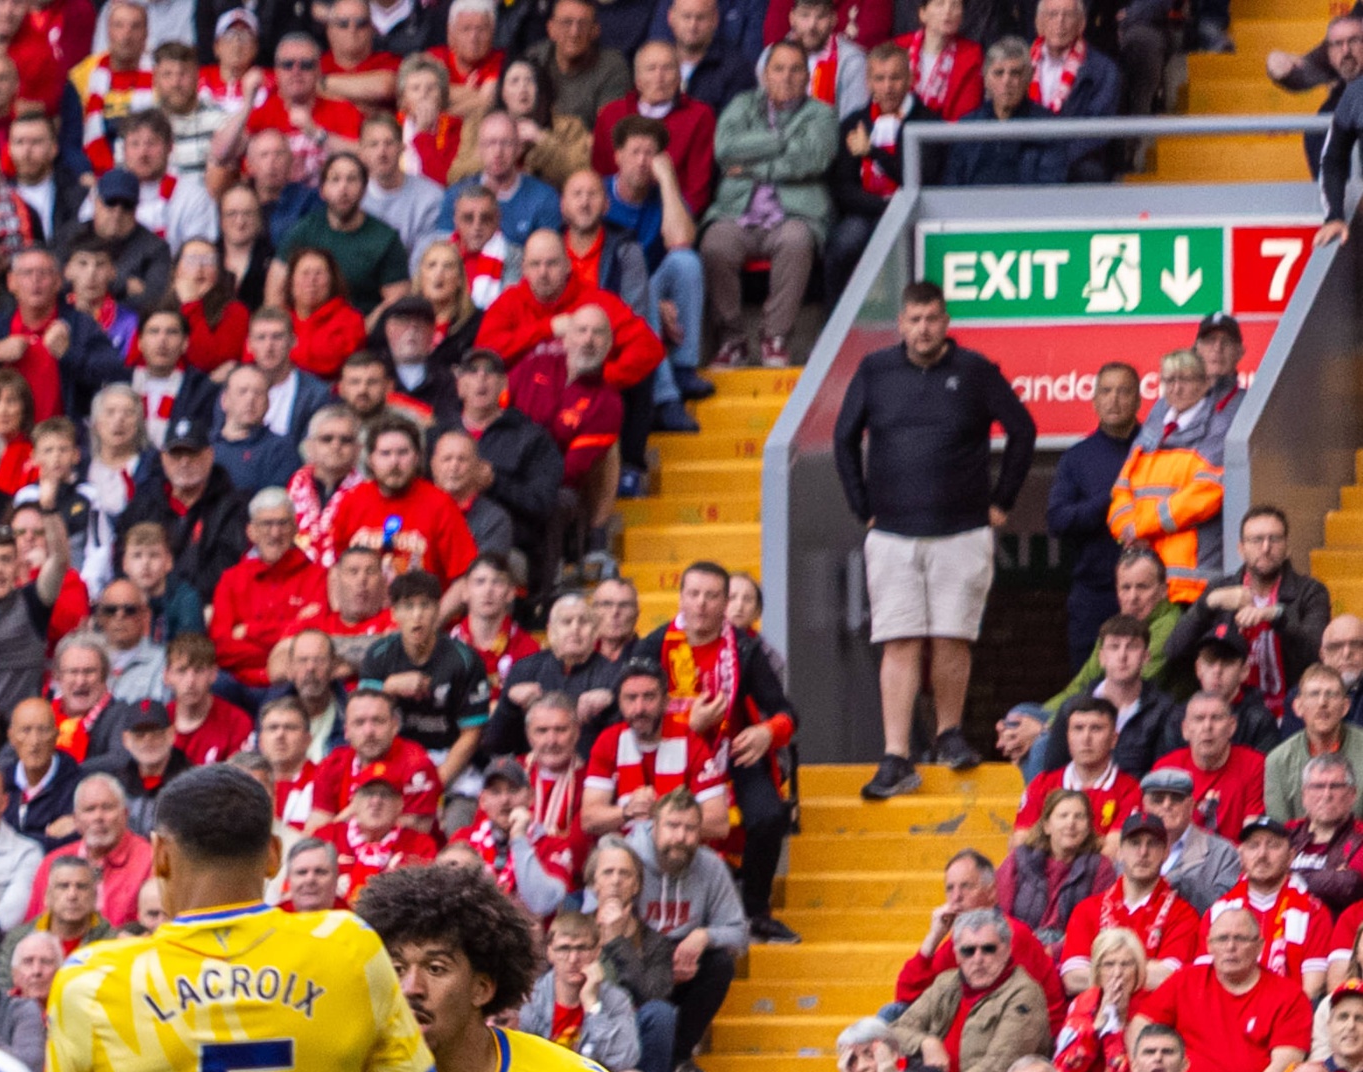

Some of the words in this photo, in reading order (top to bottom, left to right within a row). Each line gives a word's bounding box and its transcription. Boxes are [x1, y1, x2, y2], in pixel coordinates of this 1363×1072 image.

[943, 249, 1070, 301] EXIT
[1260, 237, 1304, 301] 7
[143, 965, 326, 1022] LACROIX
